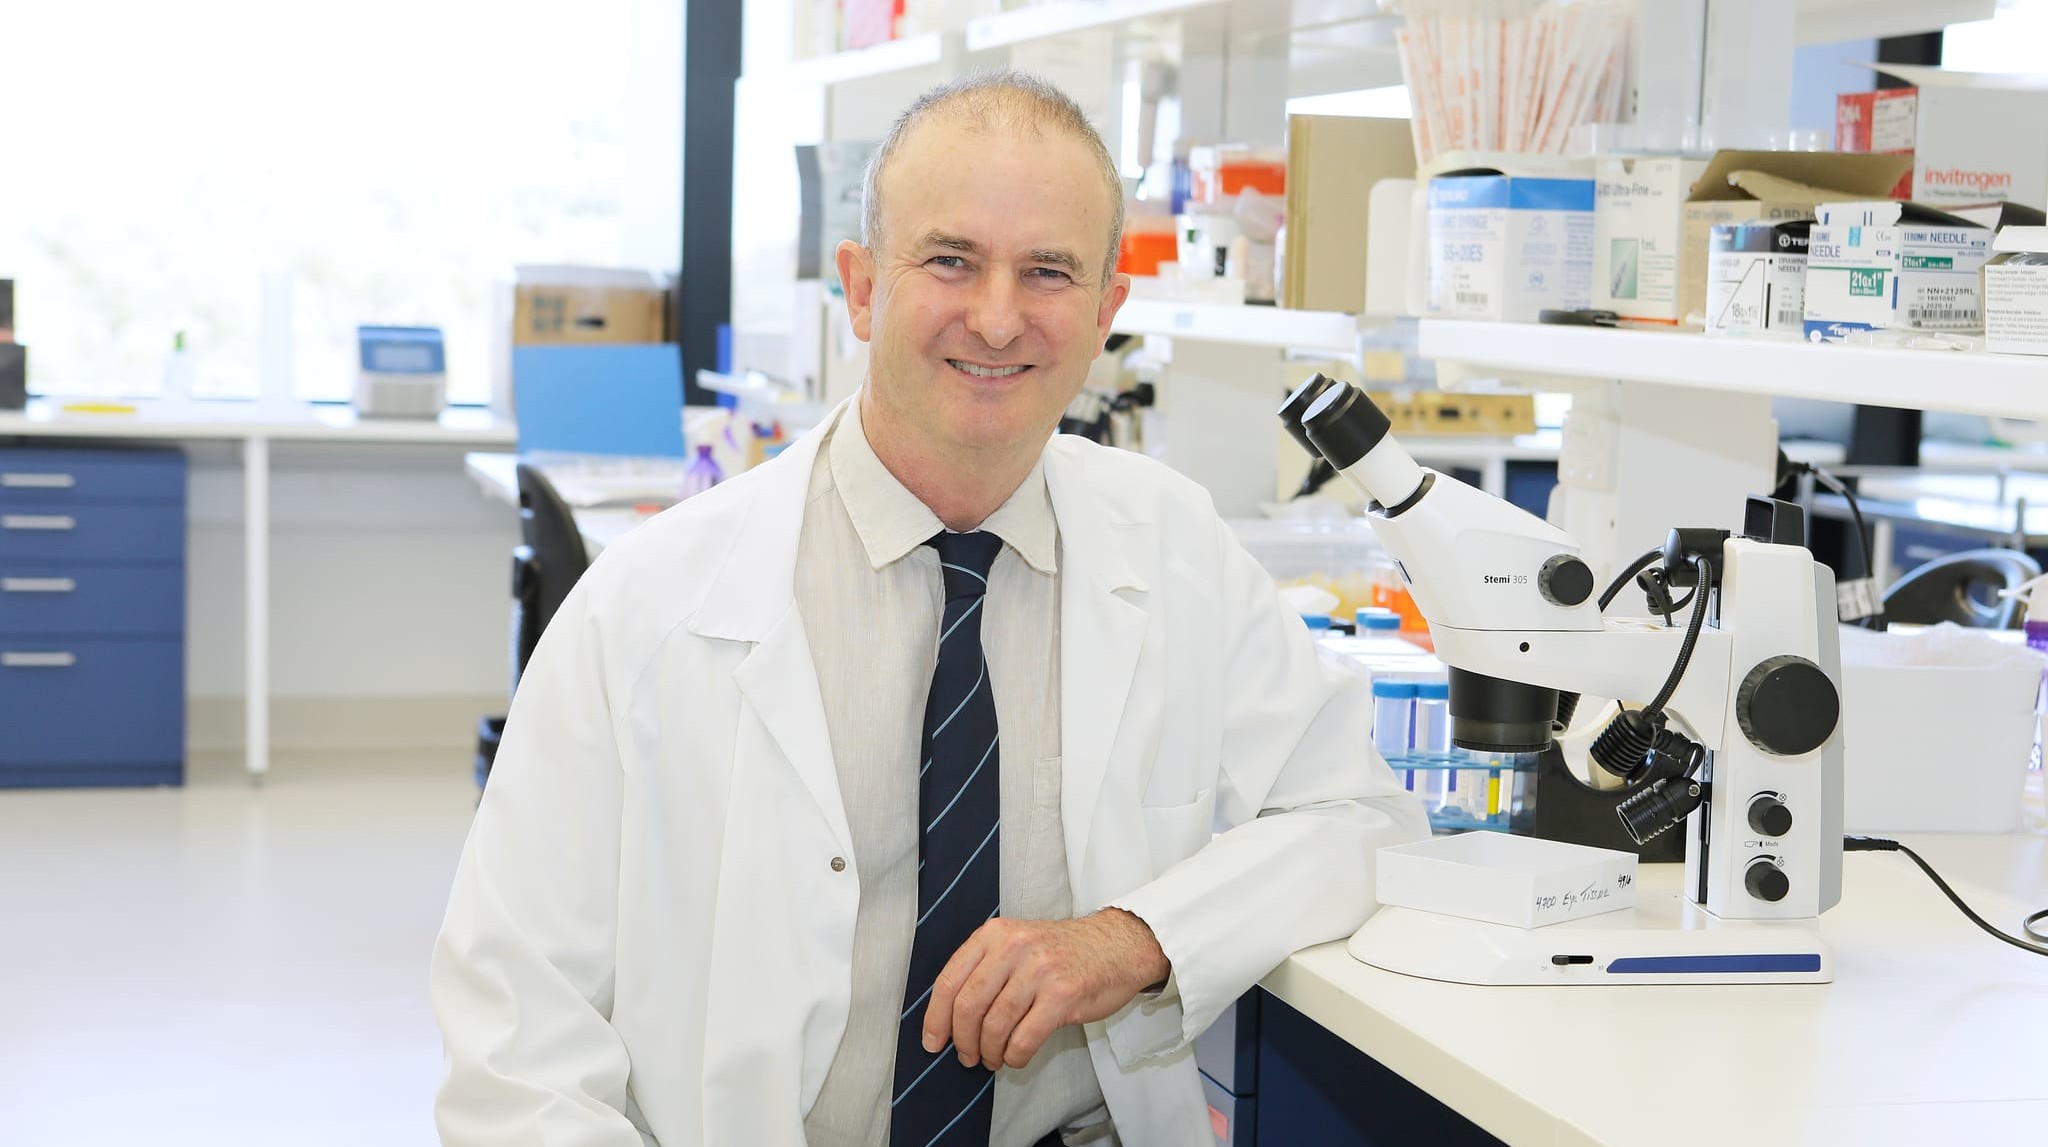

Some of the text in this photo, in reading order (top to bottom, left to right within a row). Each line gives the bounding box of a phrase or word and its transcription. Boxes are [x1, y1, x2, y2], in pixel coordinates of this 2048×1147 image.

[1924, 167, 2011, 190] invitrogen
[1930, 232, 1967, 244] NEEDLE
[1810, 245, 1840, 258] NEEDLE
[1778, 265, 1801, 273] NEEDLE
[1927, 287, 1975, 295] NN+2125RL
[1484, 574, 1528, 584] Stemi 305
